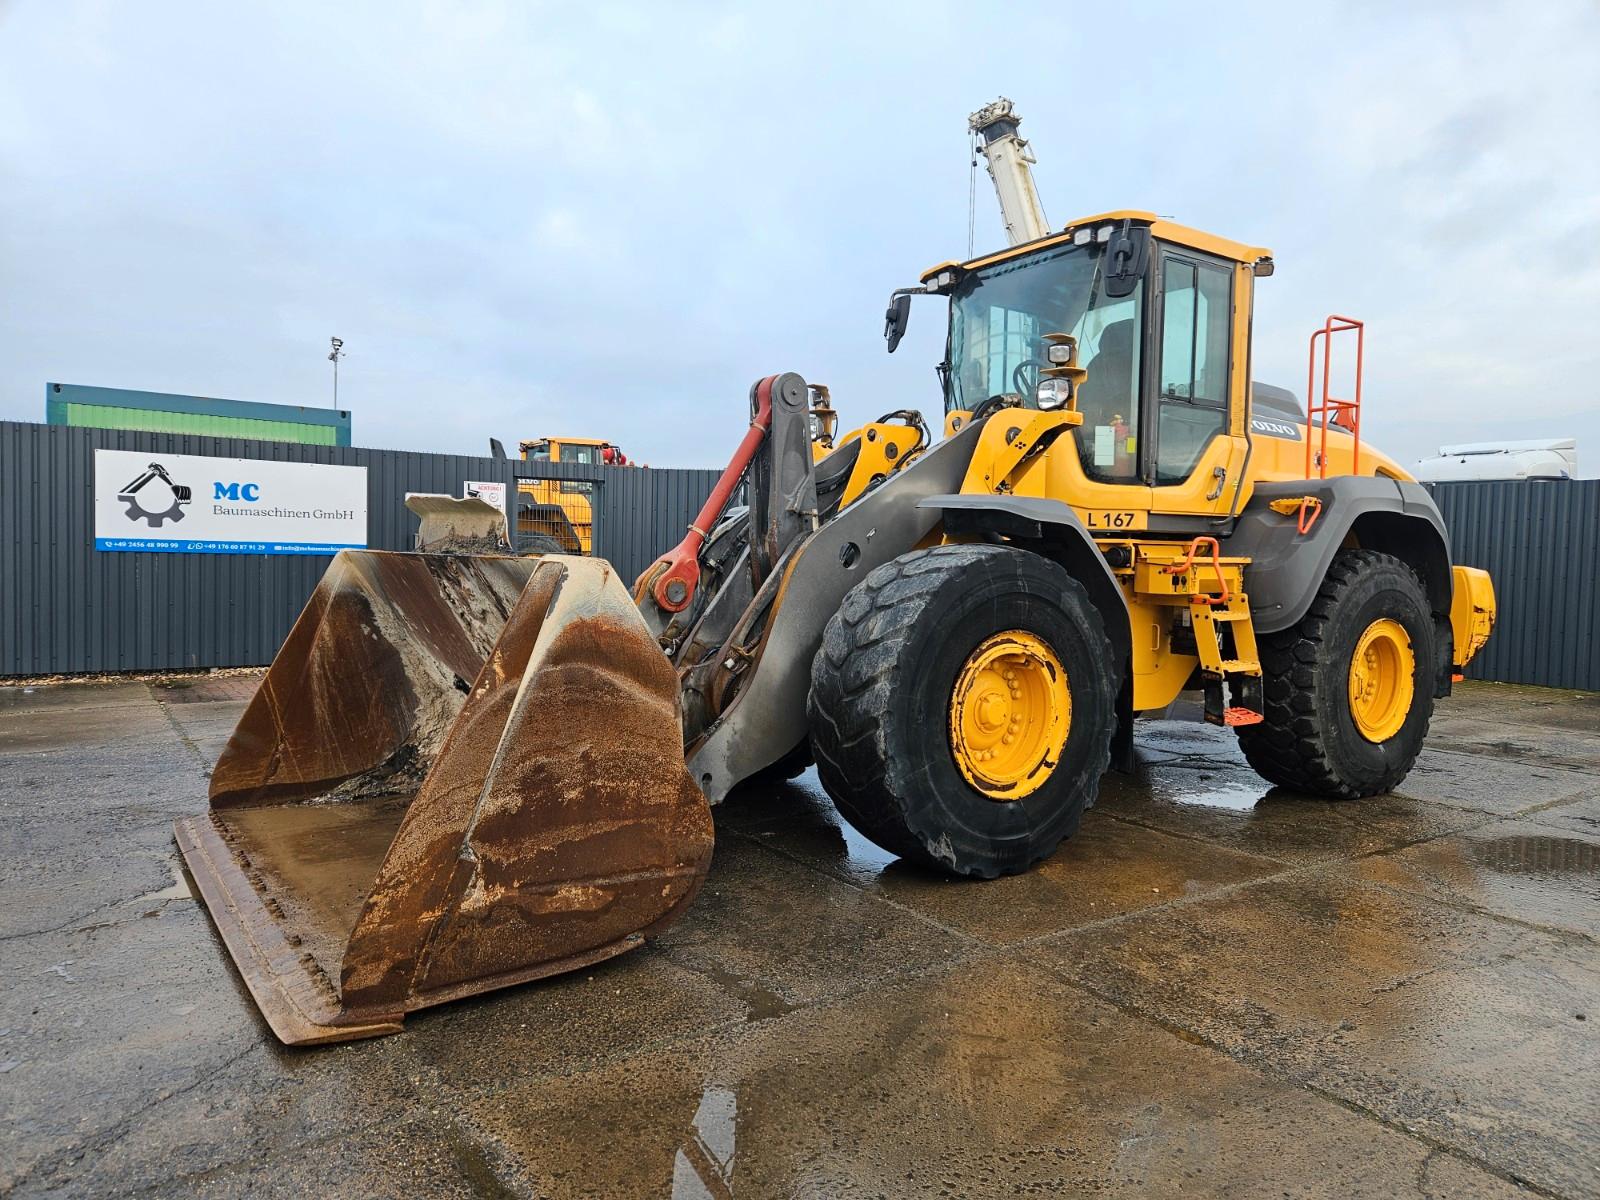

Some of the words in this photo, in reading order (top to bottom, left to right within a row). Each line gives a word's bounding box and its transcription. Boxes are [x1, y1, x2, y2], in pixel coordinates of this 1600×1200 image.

[1250, 420, 1296, 436] OLVO
[213, 481, 260, 502] MC
[213, 504, 311, 519] Baumaschinen
[312, 508, 355, 520] GmbH
[1088, 512, 1097, 527] L
[1103, 513, 1135, 528] 167
